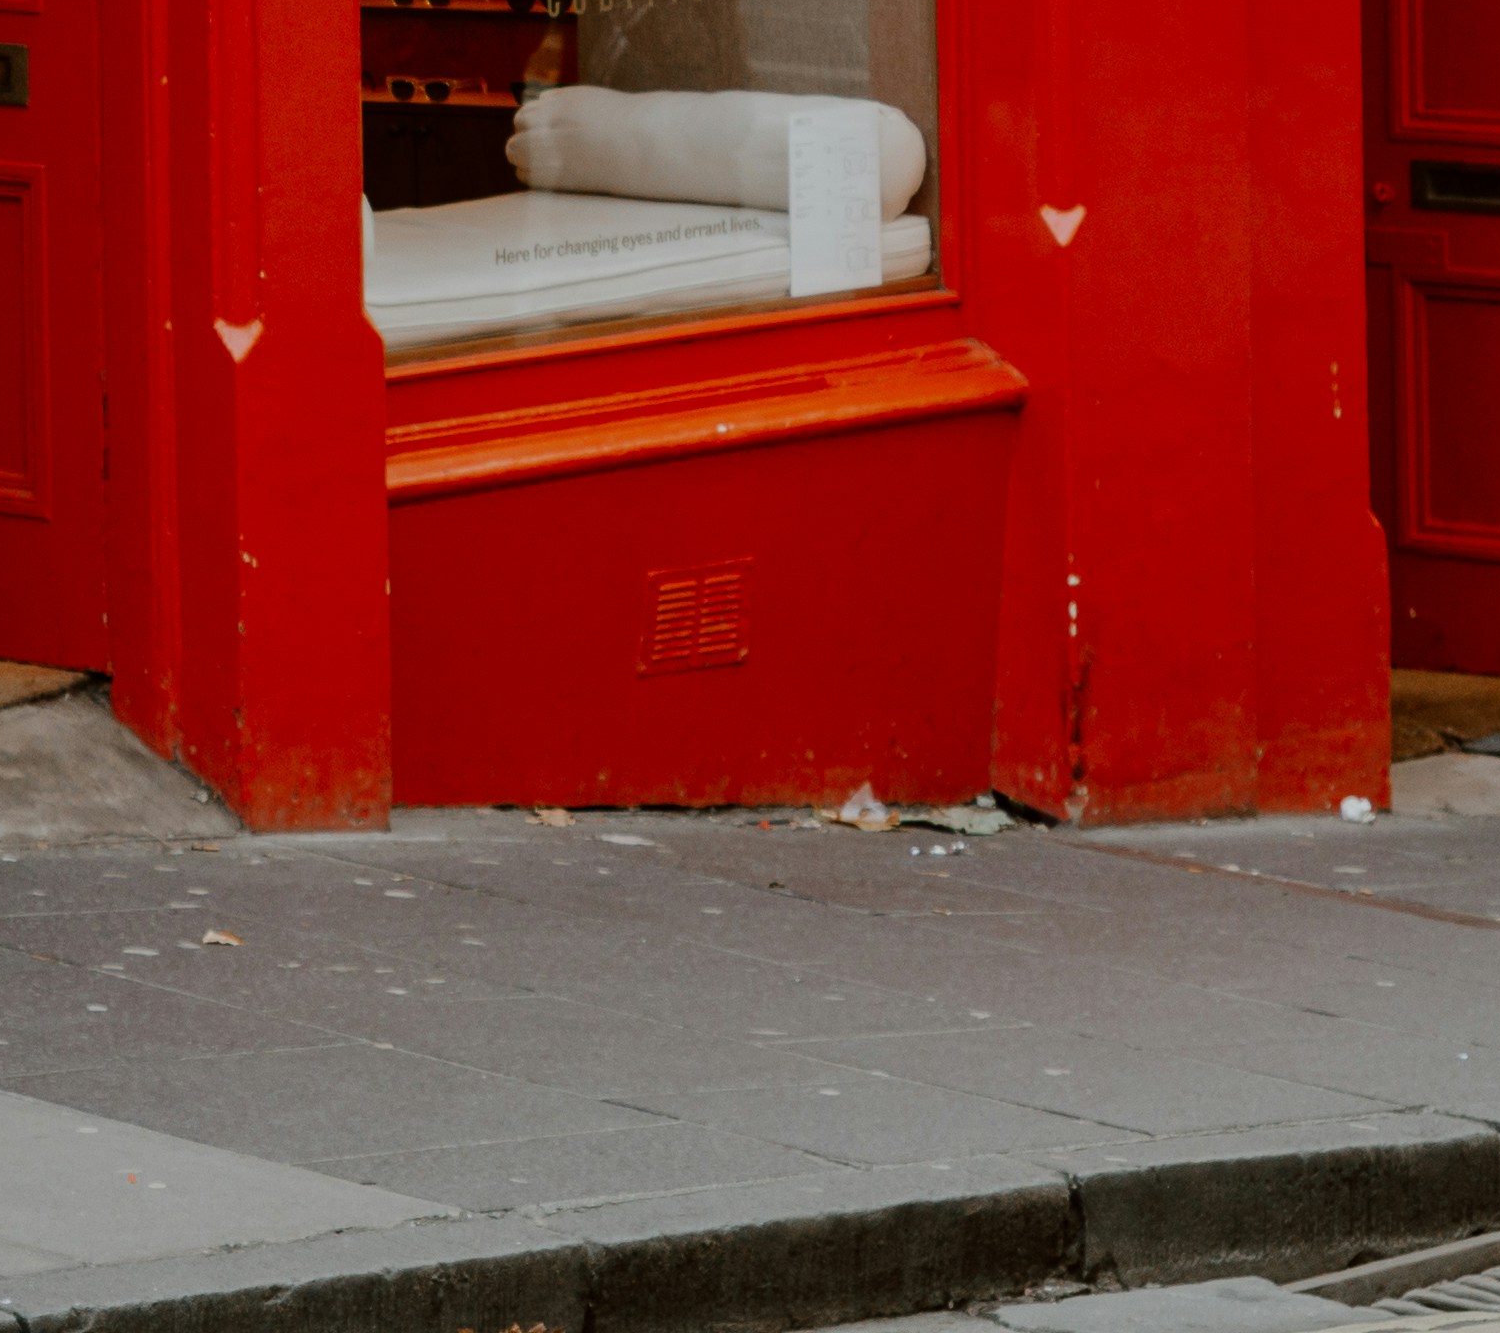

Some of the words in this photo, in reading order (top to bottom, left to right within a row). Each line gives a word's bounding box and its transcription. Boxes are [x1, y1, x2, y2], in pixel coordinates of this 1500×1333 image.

[495, 247, 530, 265] Here
[533, 243, 554, 261] for
[557, 235, 619, 258] changing
[622, 232, 653, 251] eyes
[656, 226, 681, 244] and
[684, 219, 728, 240] errant
